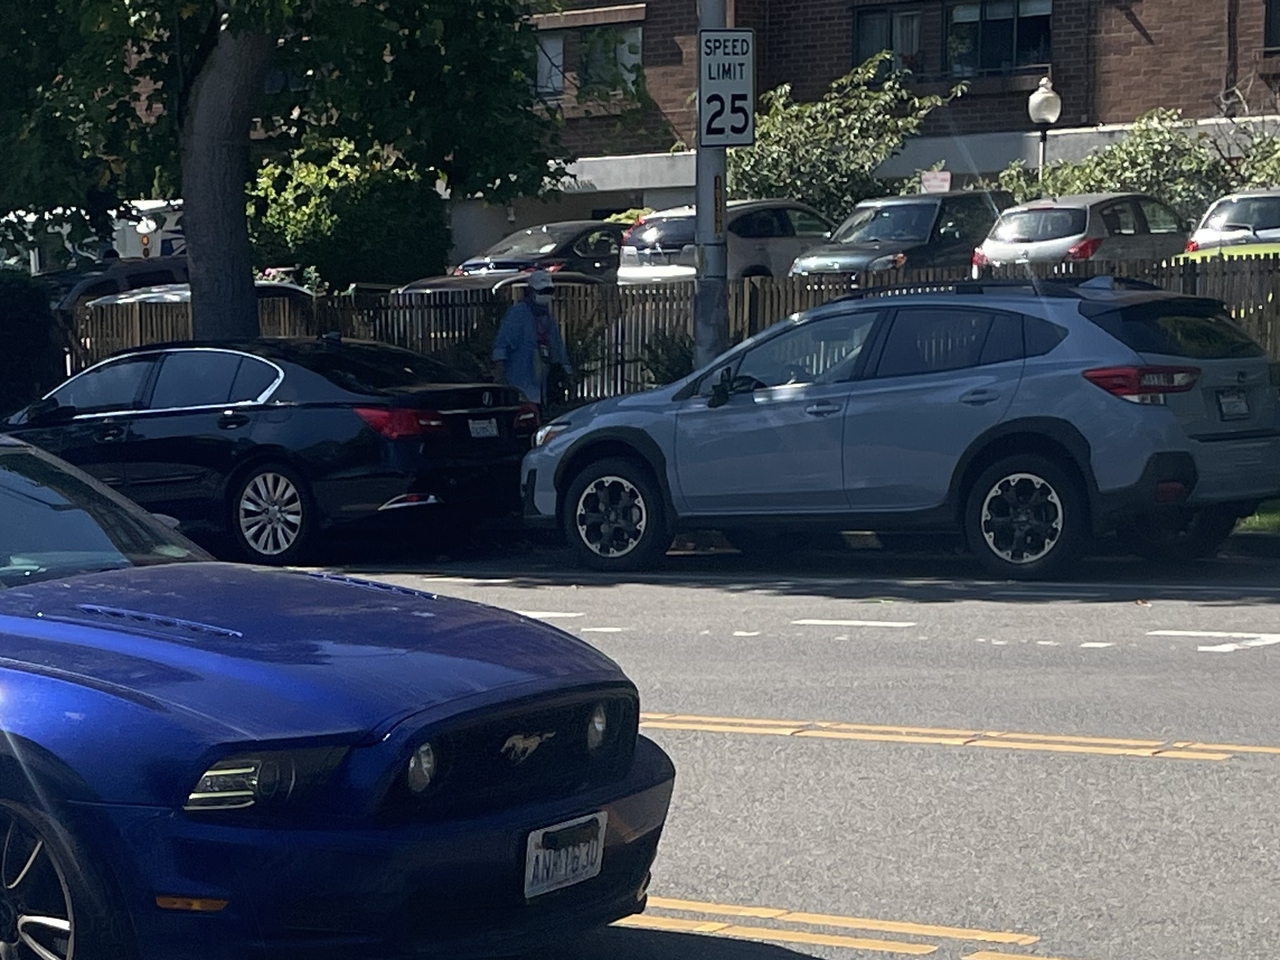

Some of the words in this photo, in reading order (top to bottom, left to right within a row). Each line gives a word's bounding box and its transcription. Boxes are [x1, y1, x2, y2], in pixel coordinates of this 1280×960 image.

[704, 38, 750, 56] SPEED
[708, 62, 745, 81] LIMIT
[706, 93, 749, 135] 25
